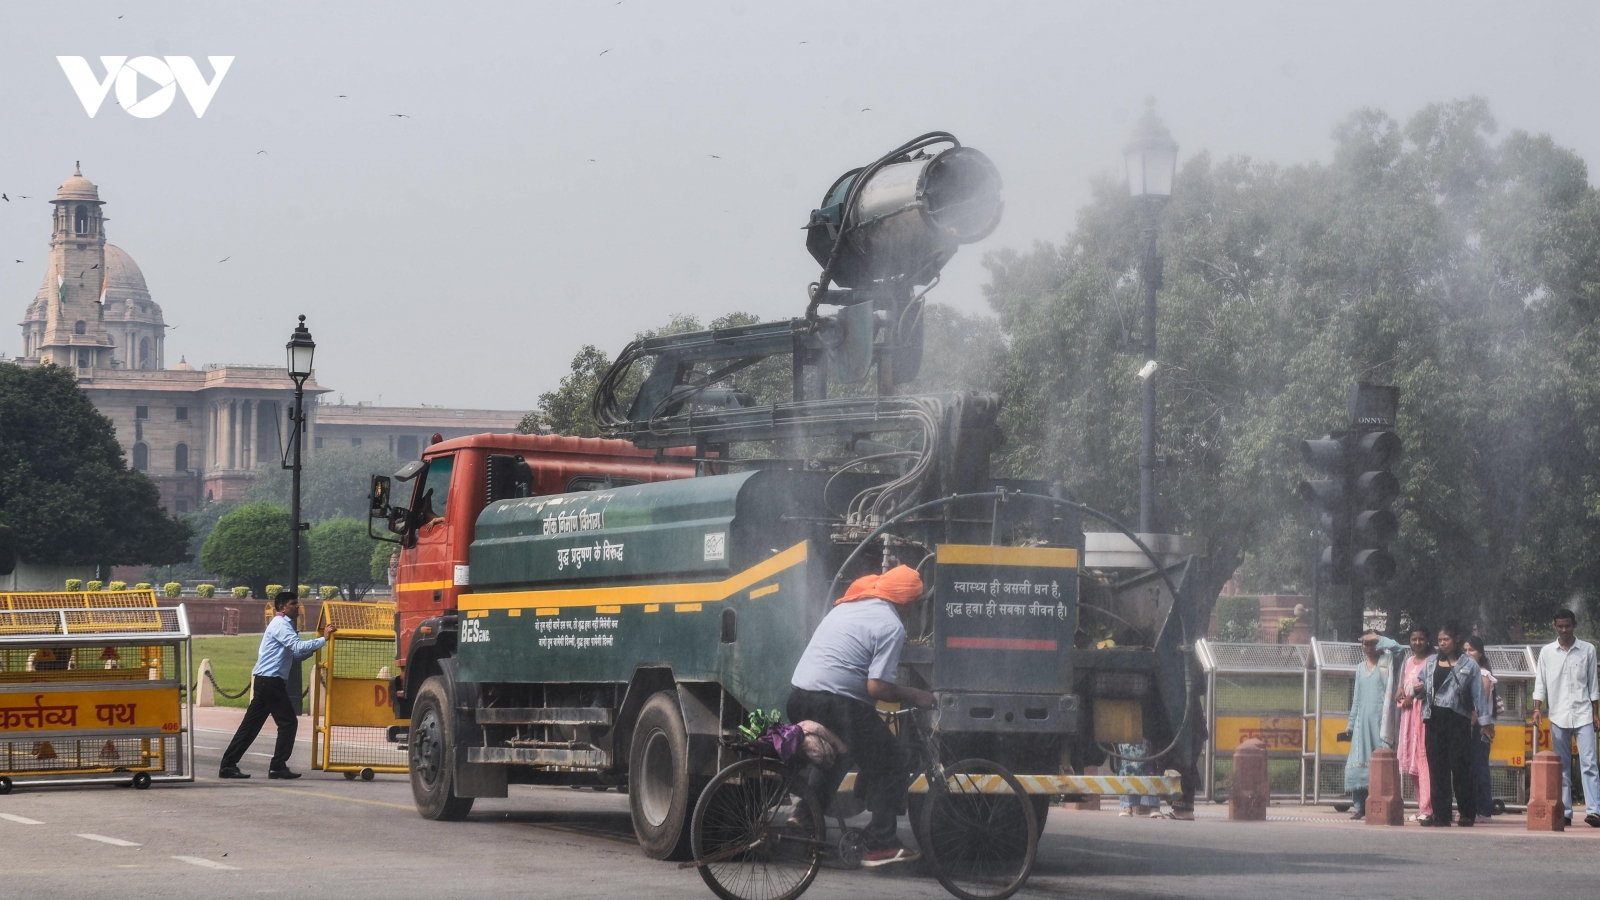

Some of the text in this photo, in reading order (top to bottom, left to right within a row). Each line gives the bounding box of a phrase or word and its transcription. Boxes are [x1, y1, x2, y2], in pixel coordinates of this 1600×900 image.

[1358, 416, 1389, 425] ONNYX
[557, 548, 570, 571] युद्ध
[593, 540, 602, 562] के
[954, 578, 1061, 599] स्वास्थ्य ही असली धन है,
[945, 602, 963, 618] शुद्ध
[965, 603, 983, 617] हवा
[985, 599, 997, 618] ही
[999, 603, 1026, 616] सबका
[1028, 601, 1054, 617] जीवन
[460, 619, 479, 642] BES
[95, 703, 136, 726] पथ
[162, 722, 179, 731] 406
[1511, 756, 1522, 765] 18
